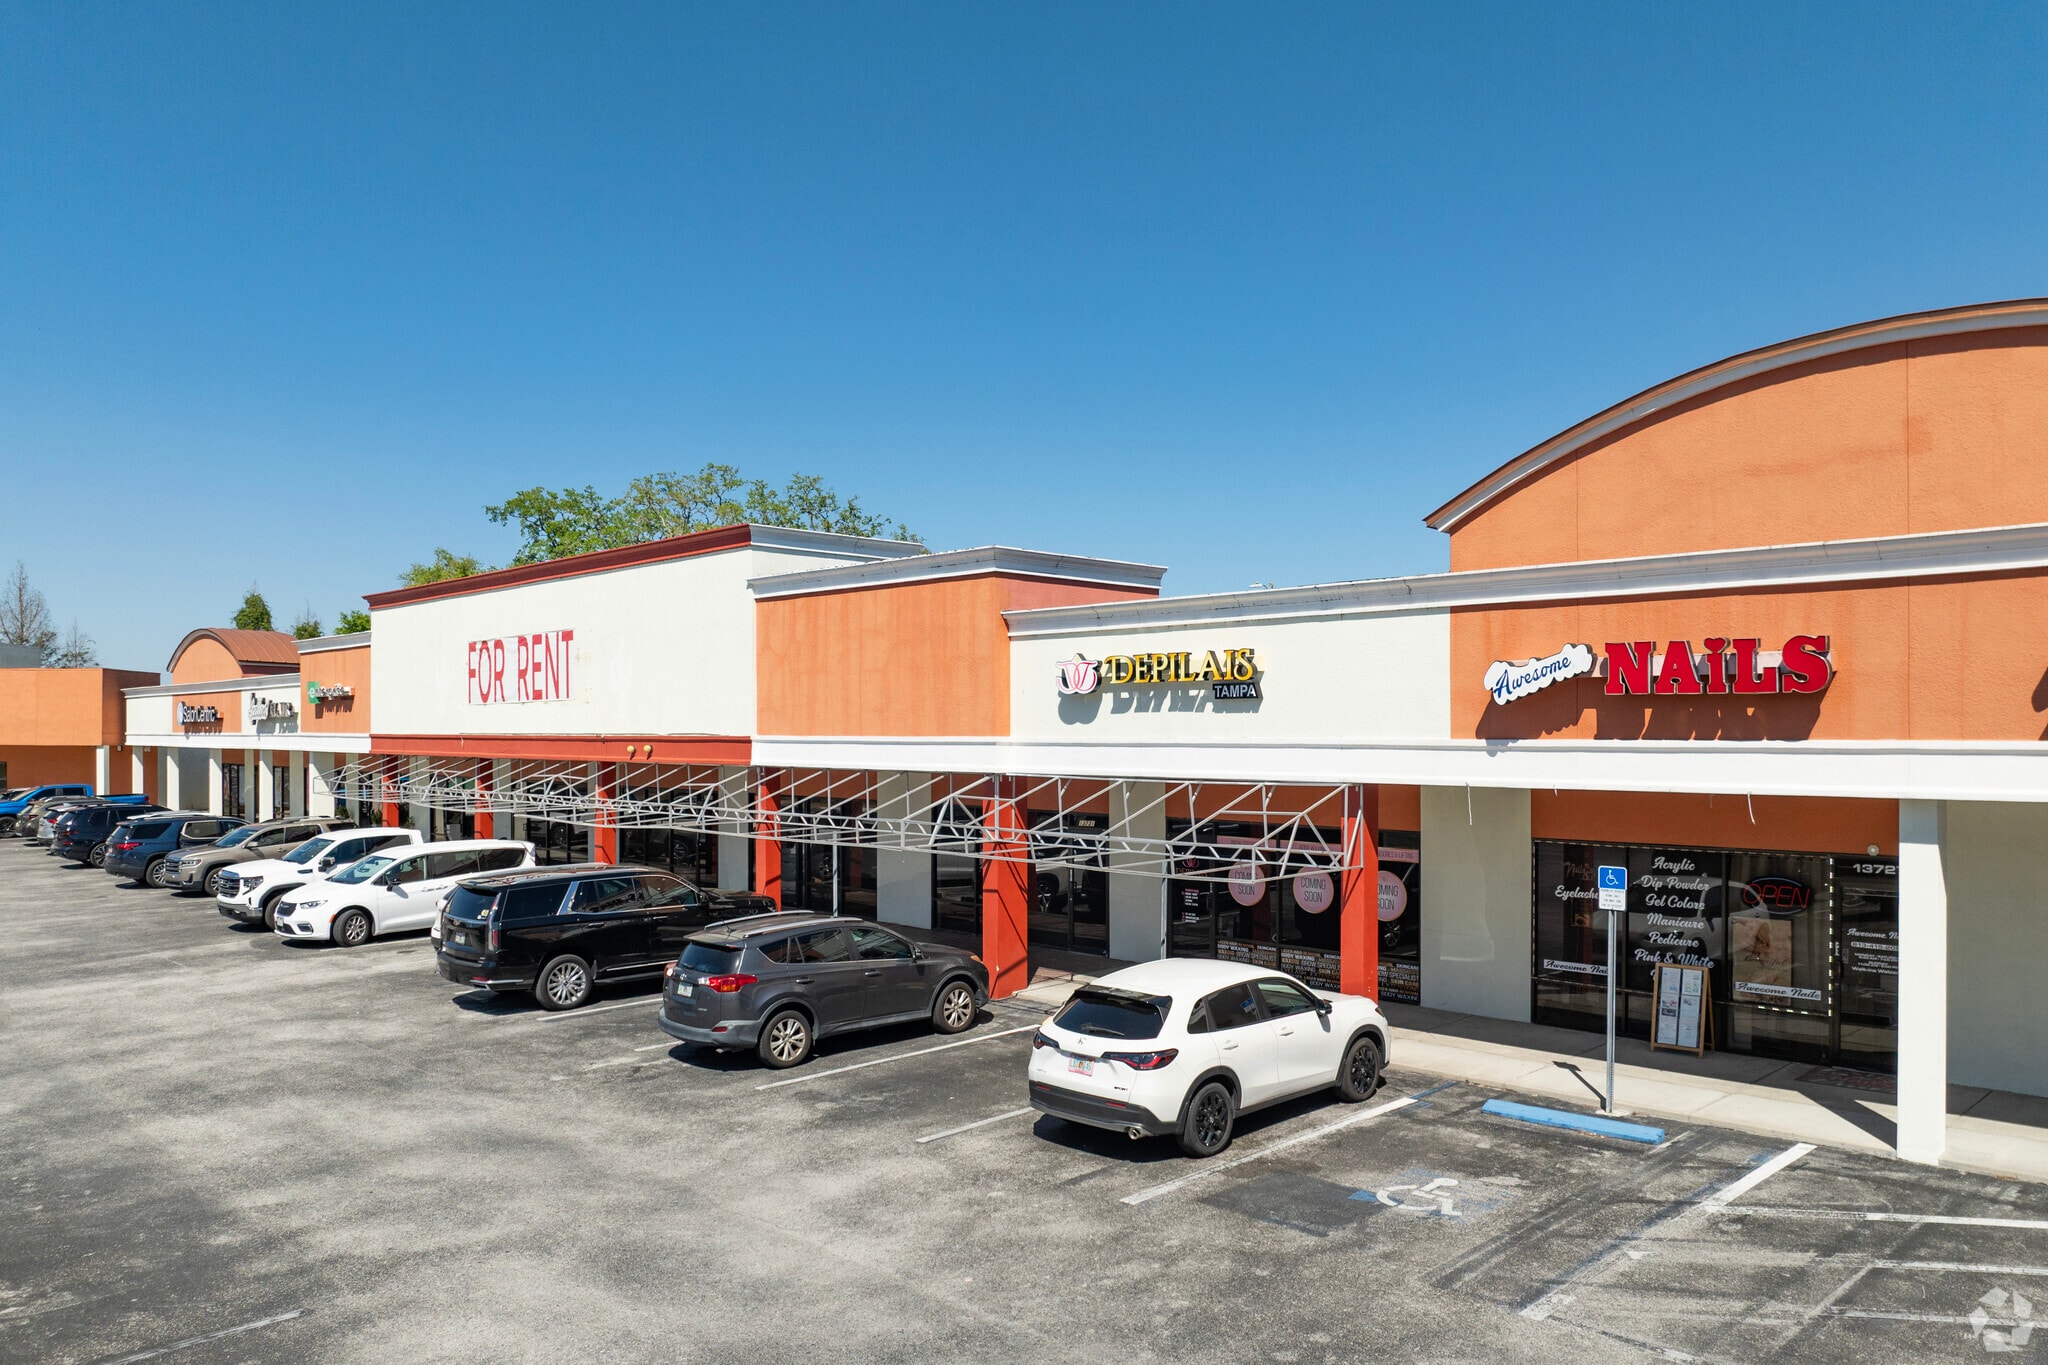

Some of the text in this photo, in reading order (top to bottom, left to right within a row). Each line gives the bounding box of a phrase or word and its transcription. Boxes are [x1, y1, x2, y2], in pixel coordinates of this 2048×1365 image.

[468, 629, 574, 704] FOR RENT
[1104, 648, 1254, 684] DEPILAIS
[1493, 656, 1572, 699] Awesome
[1214, 683, 1257, 698] TAMPA
[1652, 856, 1696, 874] Acrylic
[1852, 863, 1899, 875] 1372
[1238, 884, 1256, 896] SOON
[1301, 877, 1327, 890] COMING
[1641, 875, 1711, 892] Dip Powder
[1304, 891, 1323, 903] SOON
[1378, 897, 1395, 911] OON
[1645, 893, 1706, 911] Gel Colors
[1743, 882, 1811, 909] OPEN
[1647, 912, 1705, 930] Manicure
[1649, 931, 1700, 948] Pedicure
[1545, 960, 1588, 972] Awesome
[1634, 948, 1715, 969] Pink & White
[1737, 982, 1821, 999] Awesome Nails
